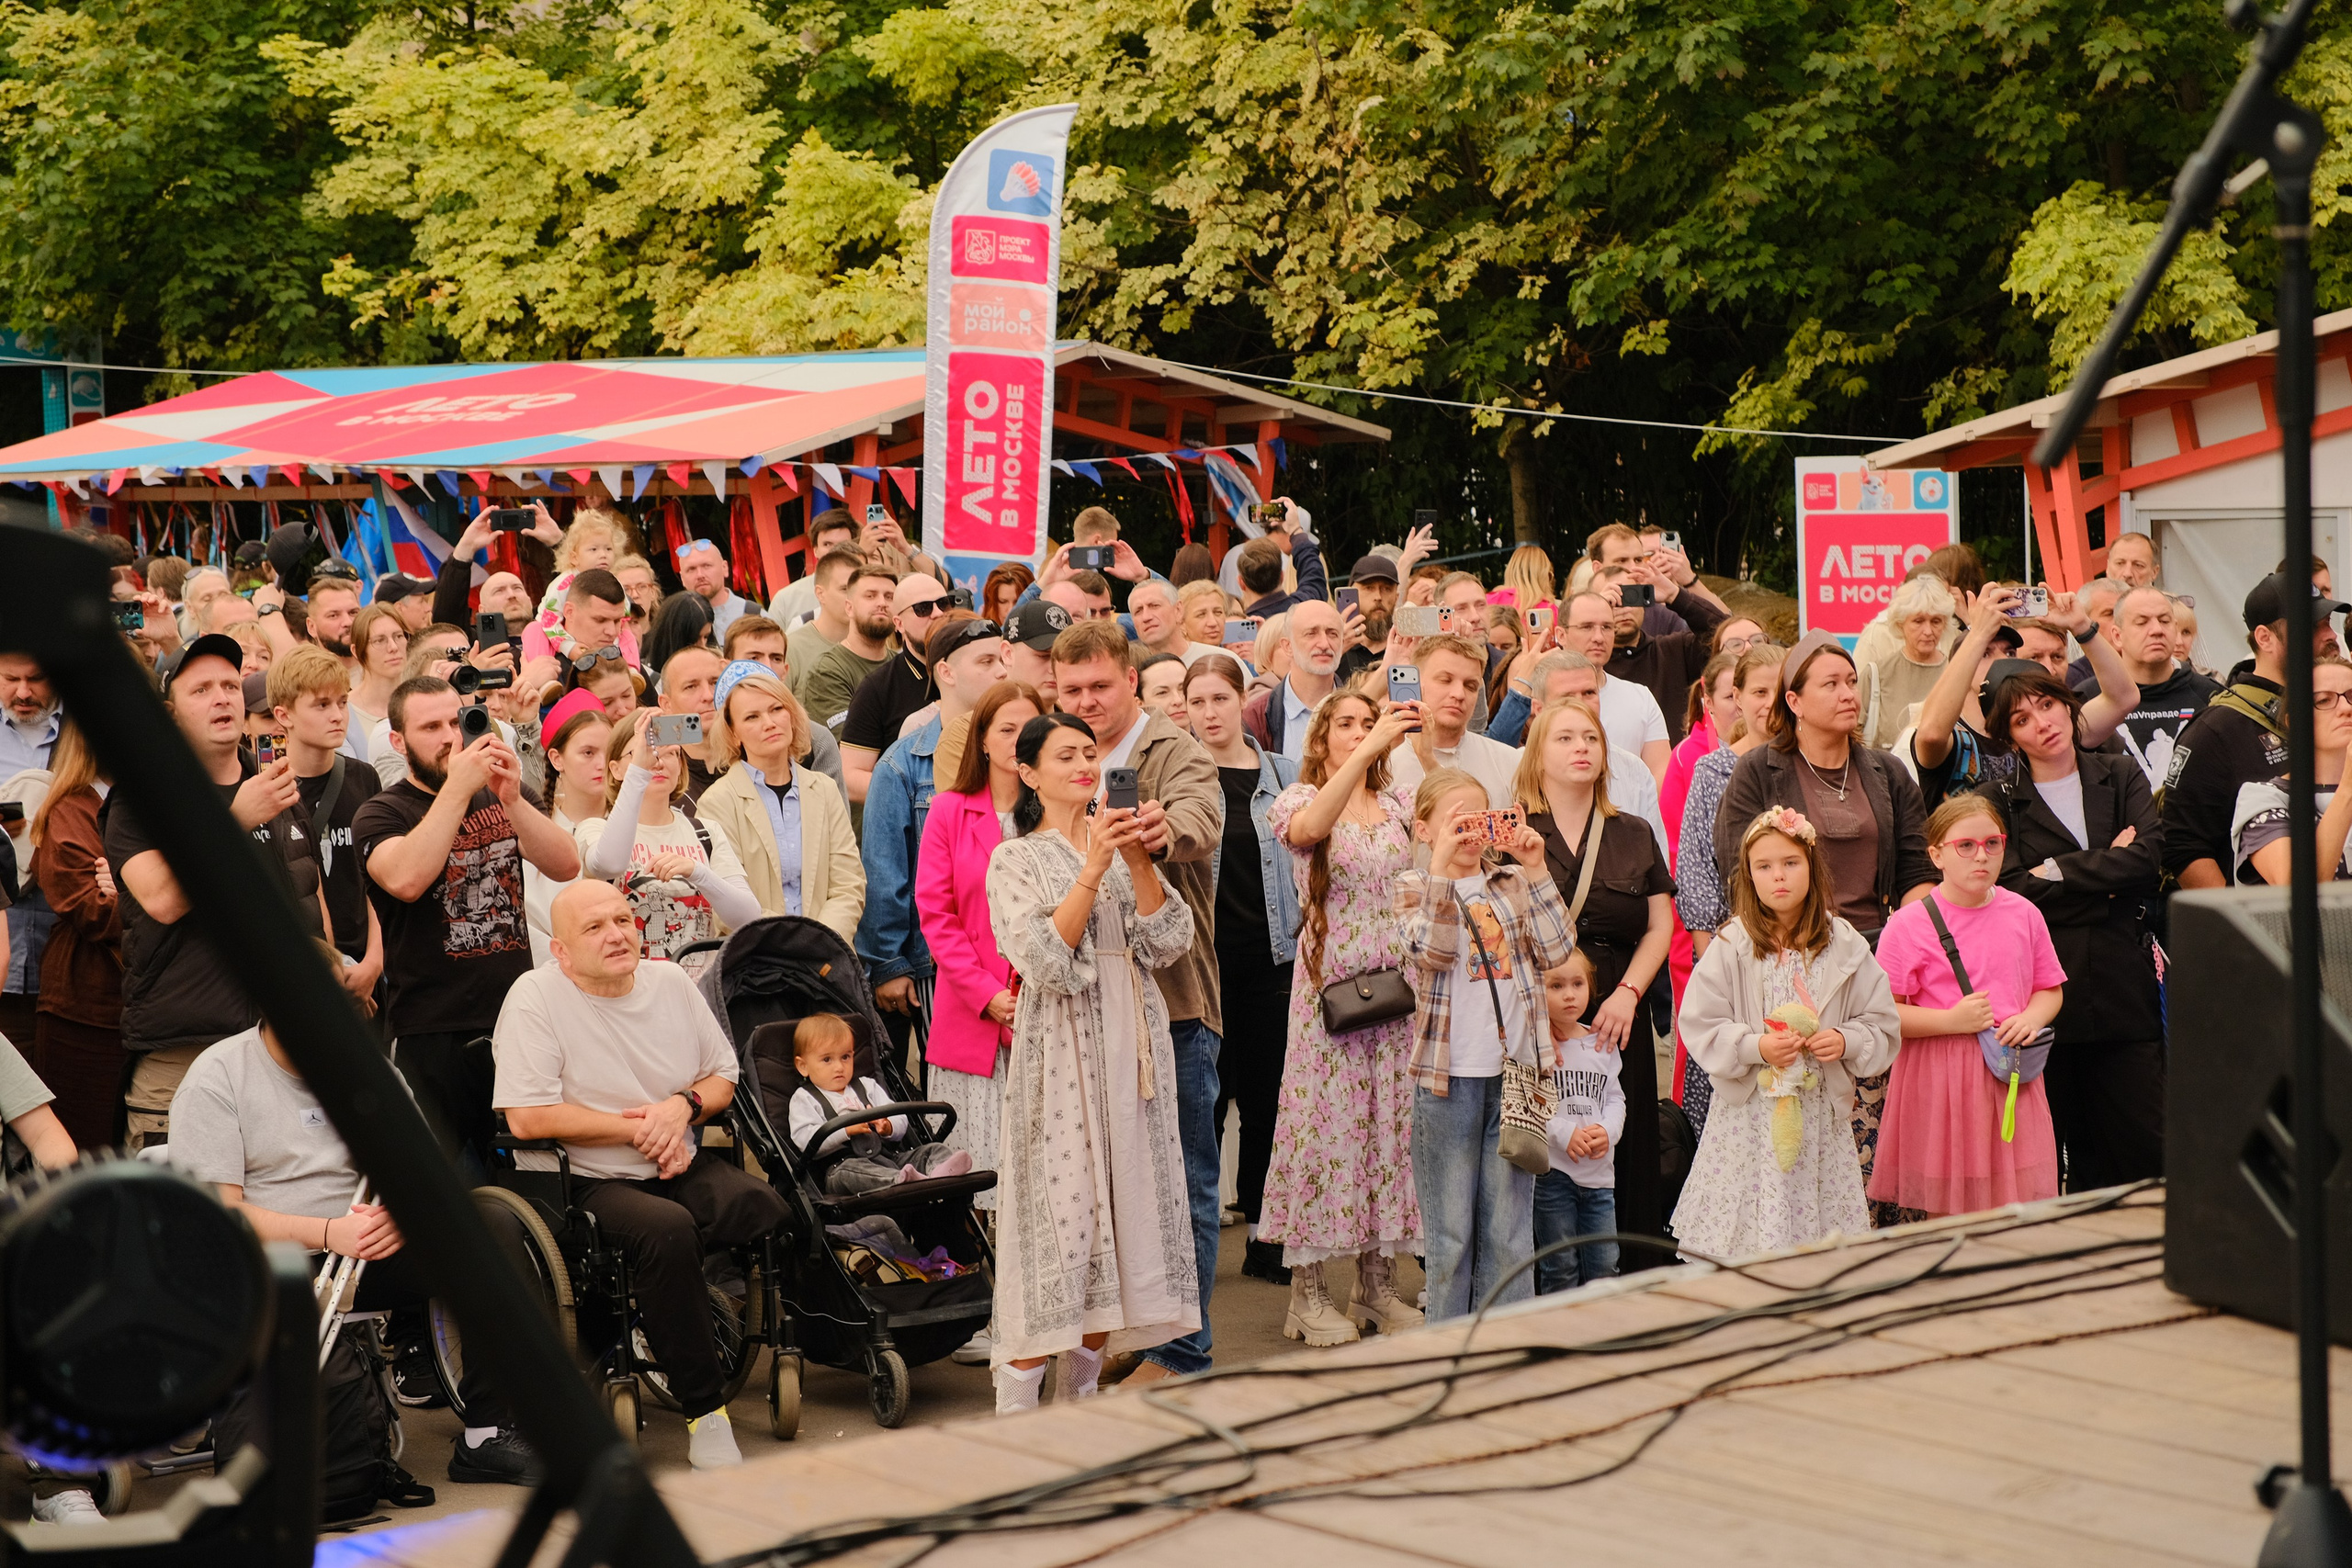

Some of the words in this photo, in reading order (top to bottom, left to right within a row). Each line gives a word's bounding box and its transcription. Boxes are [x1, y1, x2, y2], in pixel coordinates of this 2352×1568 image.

[999, 235, 1031, 246] ПРОЕКТ
[999, 243, 1023, 254] МЭРА
[999, 253, 1035, 264] МОСКВЫ
[373, 392, 577, 414] ЛЕТО
[1001, 383, 1024, 501] МОСКВЕ
[961, 380, 1000, 525] ЛЕТО
[1000, 509, 1019, 528] В
[1819, 544, 1933, 579] ЛЕТО
[1820, 585, 1835, 604] В
[1841, 585, 1897, 604] МОС
[1553, 1069, 1608, 1119] УССКАЯ
